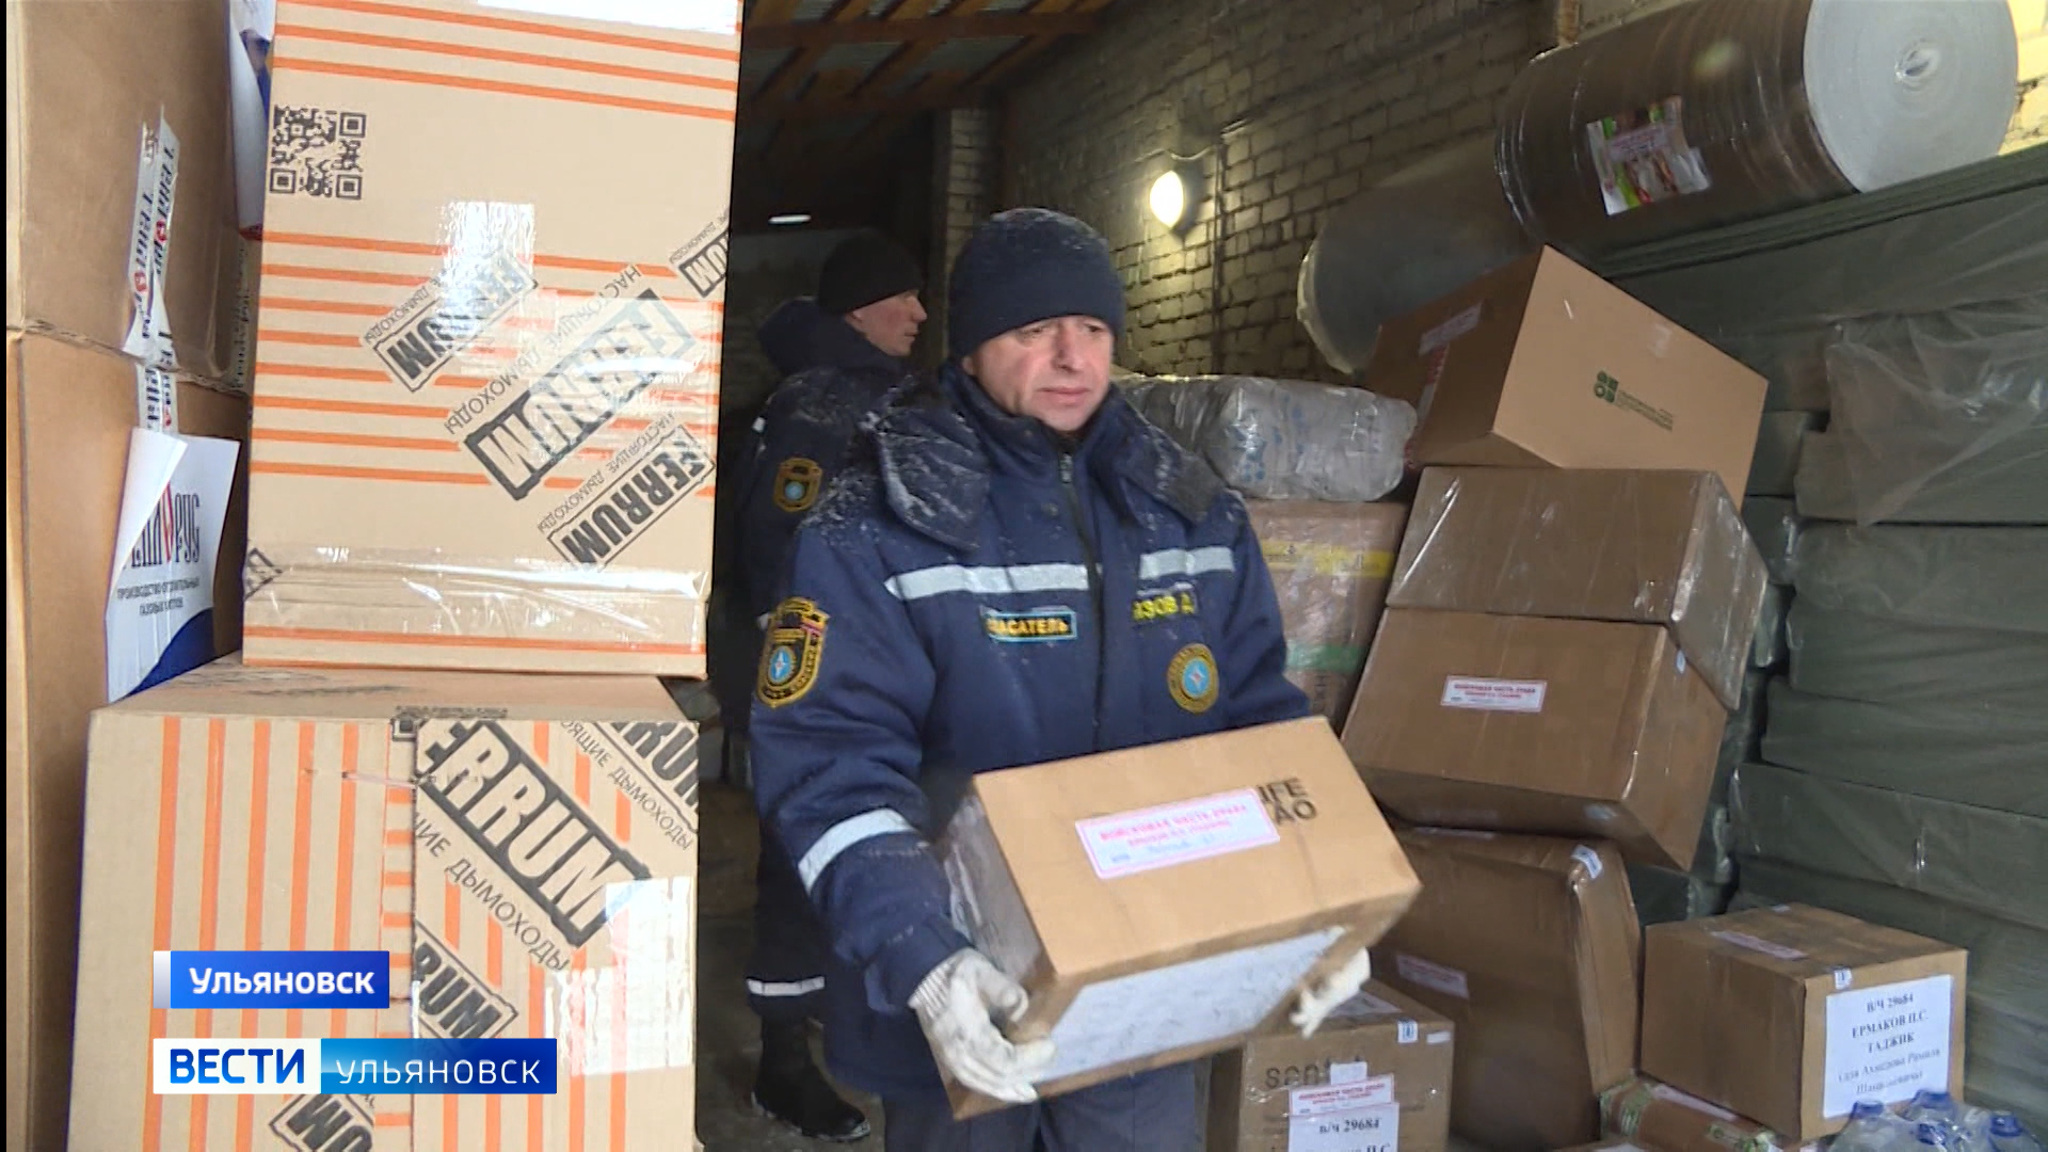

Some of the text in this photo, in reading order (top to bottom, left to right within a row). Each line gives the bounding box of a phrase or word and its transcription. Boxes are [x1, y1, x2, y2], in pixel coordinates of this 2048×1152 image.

[443, 350, 542, 435] ДЫМОХОДЫ
[475, 303, 691, 490] FERRUM
[560, 441, 706, 564] FERRUM
[608, 766, 694, 851] ДЫМОХОДЫ
[444, 858, 571, 972] ДЫМОХОДЫ
[1343, 1117, 1380, 1132] 29684
